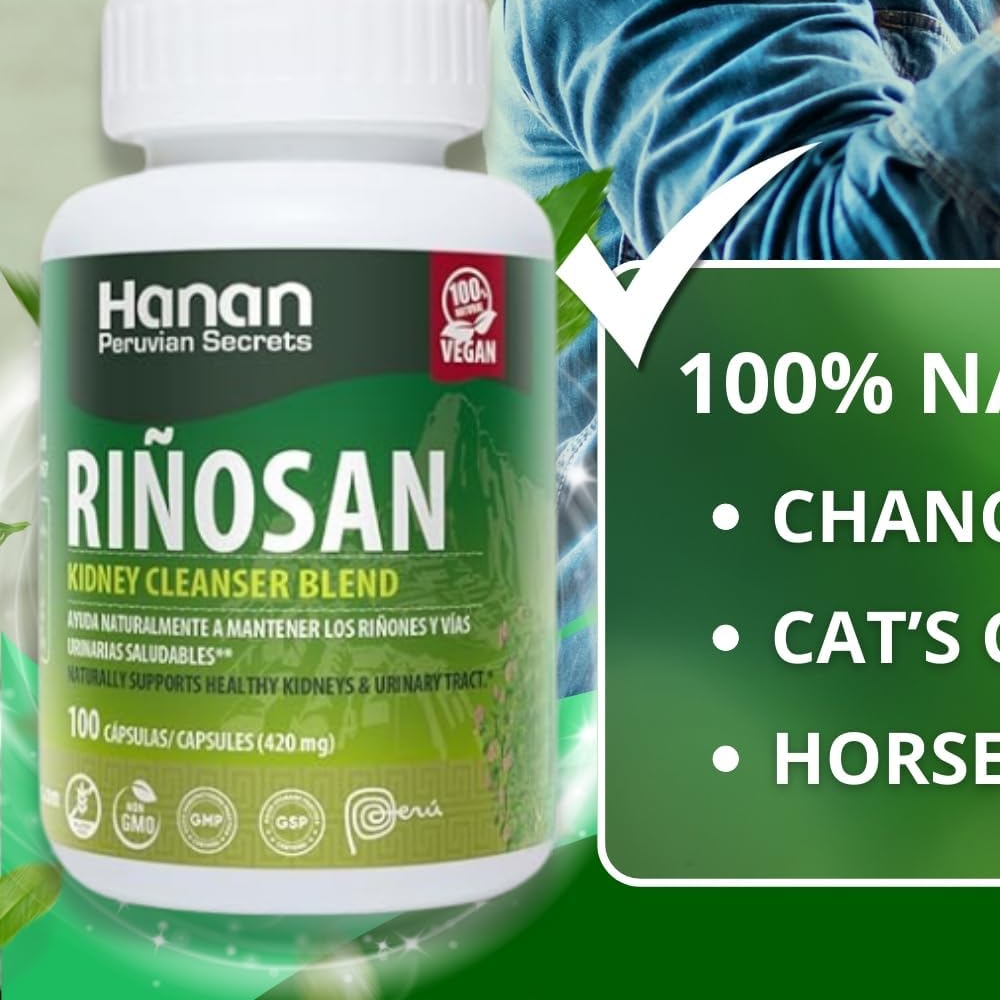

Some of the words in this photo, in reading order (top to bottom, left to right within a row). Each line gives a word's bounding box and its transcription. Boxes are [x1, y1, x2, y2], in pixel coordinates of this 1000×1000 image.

[98, 279, 313, 330] Hanan
[98, 330, 195, 354] Peruvian
[202, 329, 313, 353] Secrets
[440, 339, 497, 364] VEGAN
[67, 426, 446, 554] RIÑOSAN
[67, 562, 141, 595] KIDNEY
[145, 566, 289, 599] CLEANSER
[299, 567, 400, 599] BLEND
[67, 608, 99, 631] AYUDA
[101, 612, 209, 638] NATURALMENTE
[212, 618, 224, 638] A
[227, 617, 320, 639] MANTENER
[324, 617, 355, 639] LOS
[358, 614, 427, 638] RIÑONES
[429, 616, 439, 635] Y
[441, 610, 471, 635] VÍAS
[67, 636, 124, 661] URINARIAS
[67, 664, 126, 689] NATURALLY
[128, 670, 201, 694] SUPPORTS
[205, 676, 279, 695] HEALTHY
[282, 676, 354, 696] KIDNEYS
[357, 675, 370, 694] &
[374, 673, 442, 695] URINARY
[67, 706, 100, 741] 100
[176, 729, 255, 752] CAPSULES
[257, 731, 296, 754] (420
[300, 733, 336, 757] mg)
[121, 813, 155, 834] GMO
[190, 813, 223, 827] GMP
[275, 814, 309, 830] GSP
